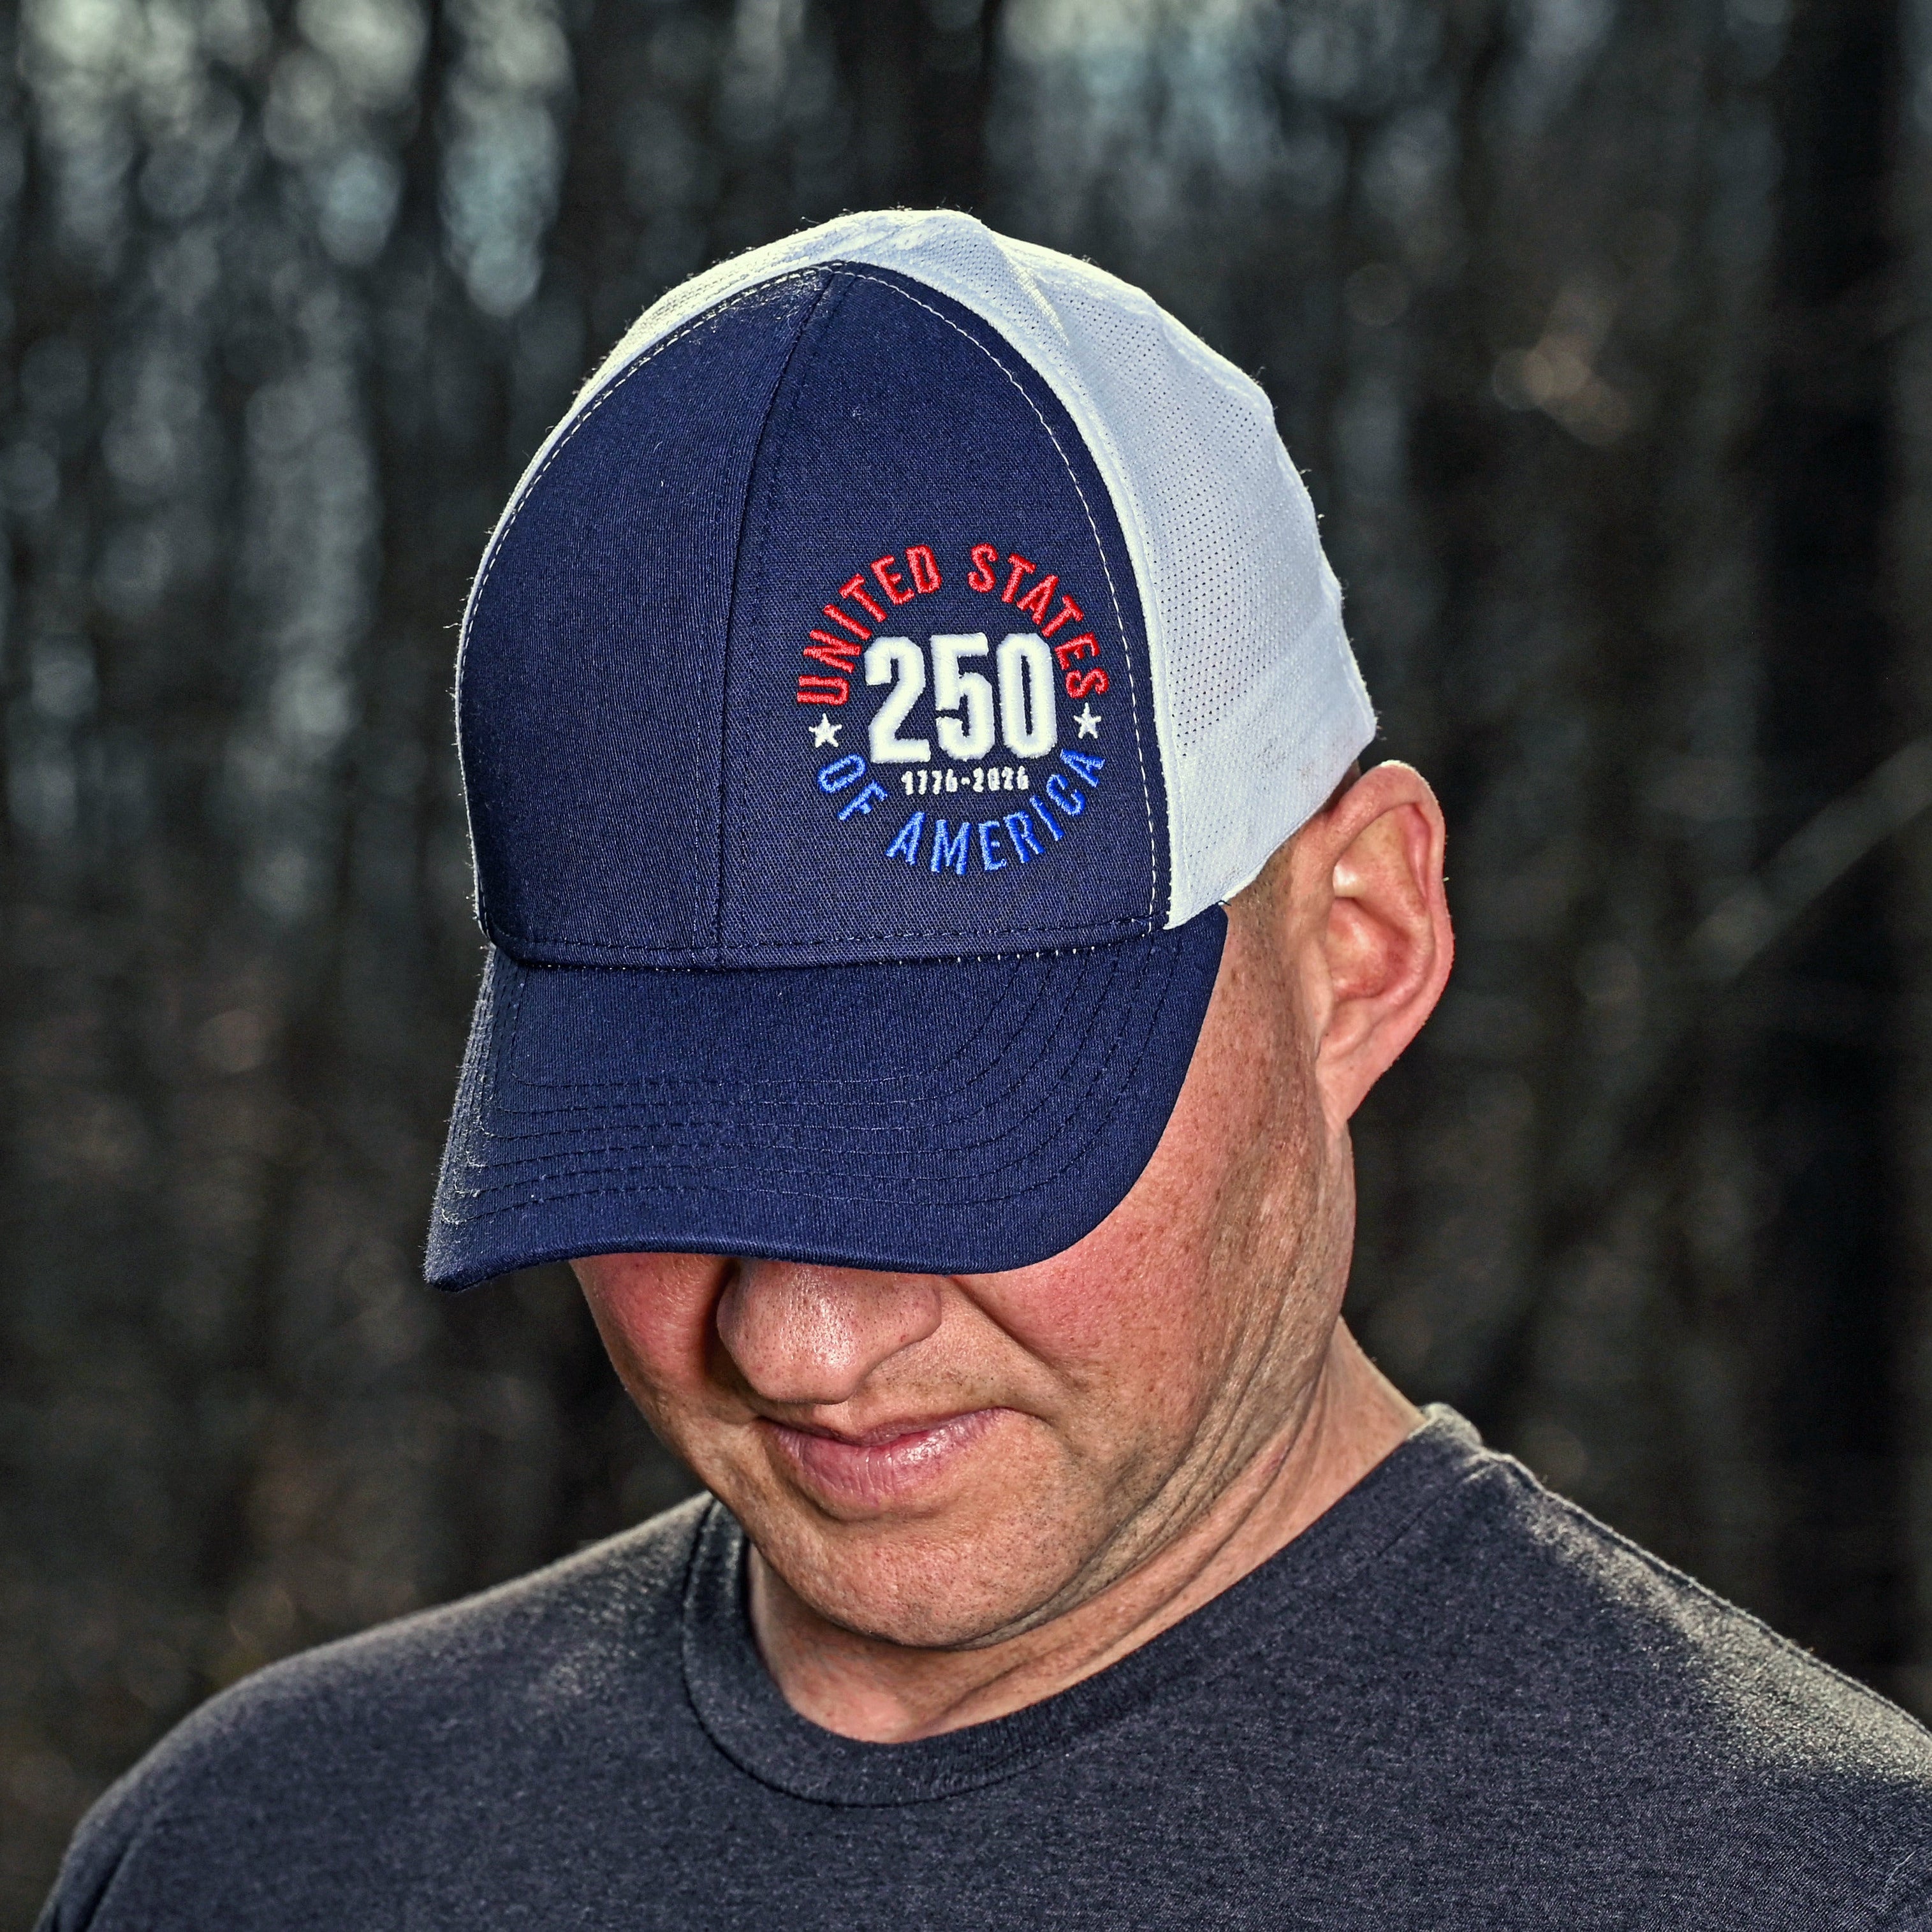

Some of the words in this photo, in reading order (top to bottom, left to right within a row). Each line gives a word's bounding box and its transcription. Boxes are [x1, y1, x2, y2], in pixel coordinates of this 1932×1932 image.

[796, 544, 943, 706] UNITED
[967, 543, 1109, 699] STATES
[864, 632, 1058, 764] 250
[817, 752, 889, 823] OF
[885, 748, 1106, 875] AMERICA
[900, 765, 1029, 796] 1776-2026
